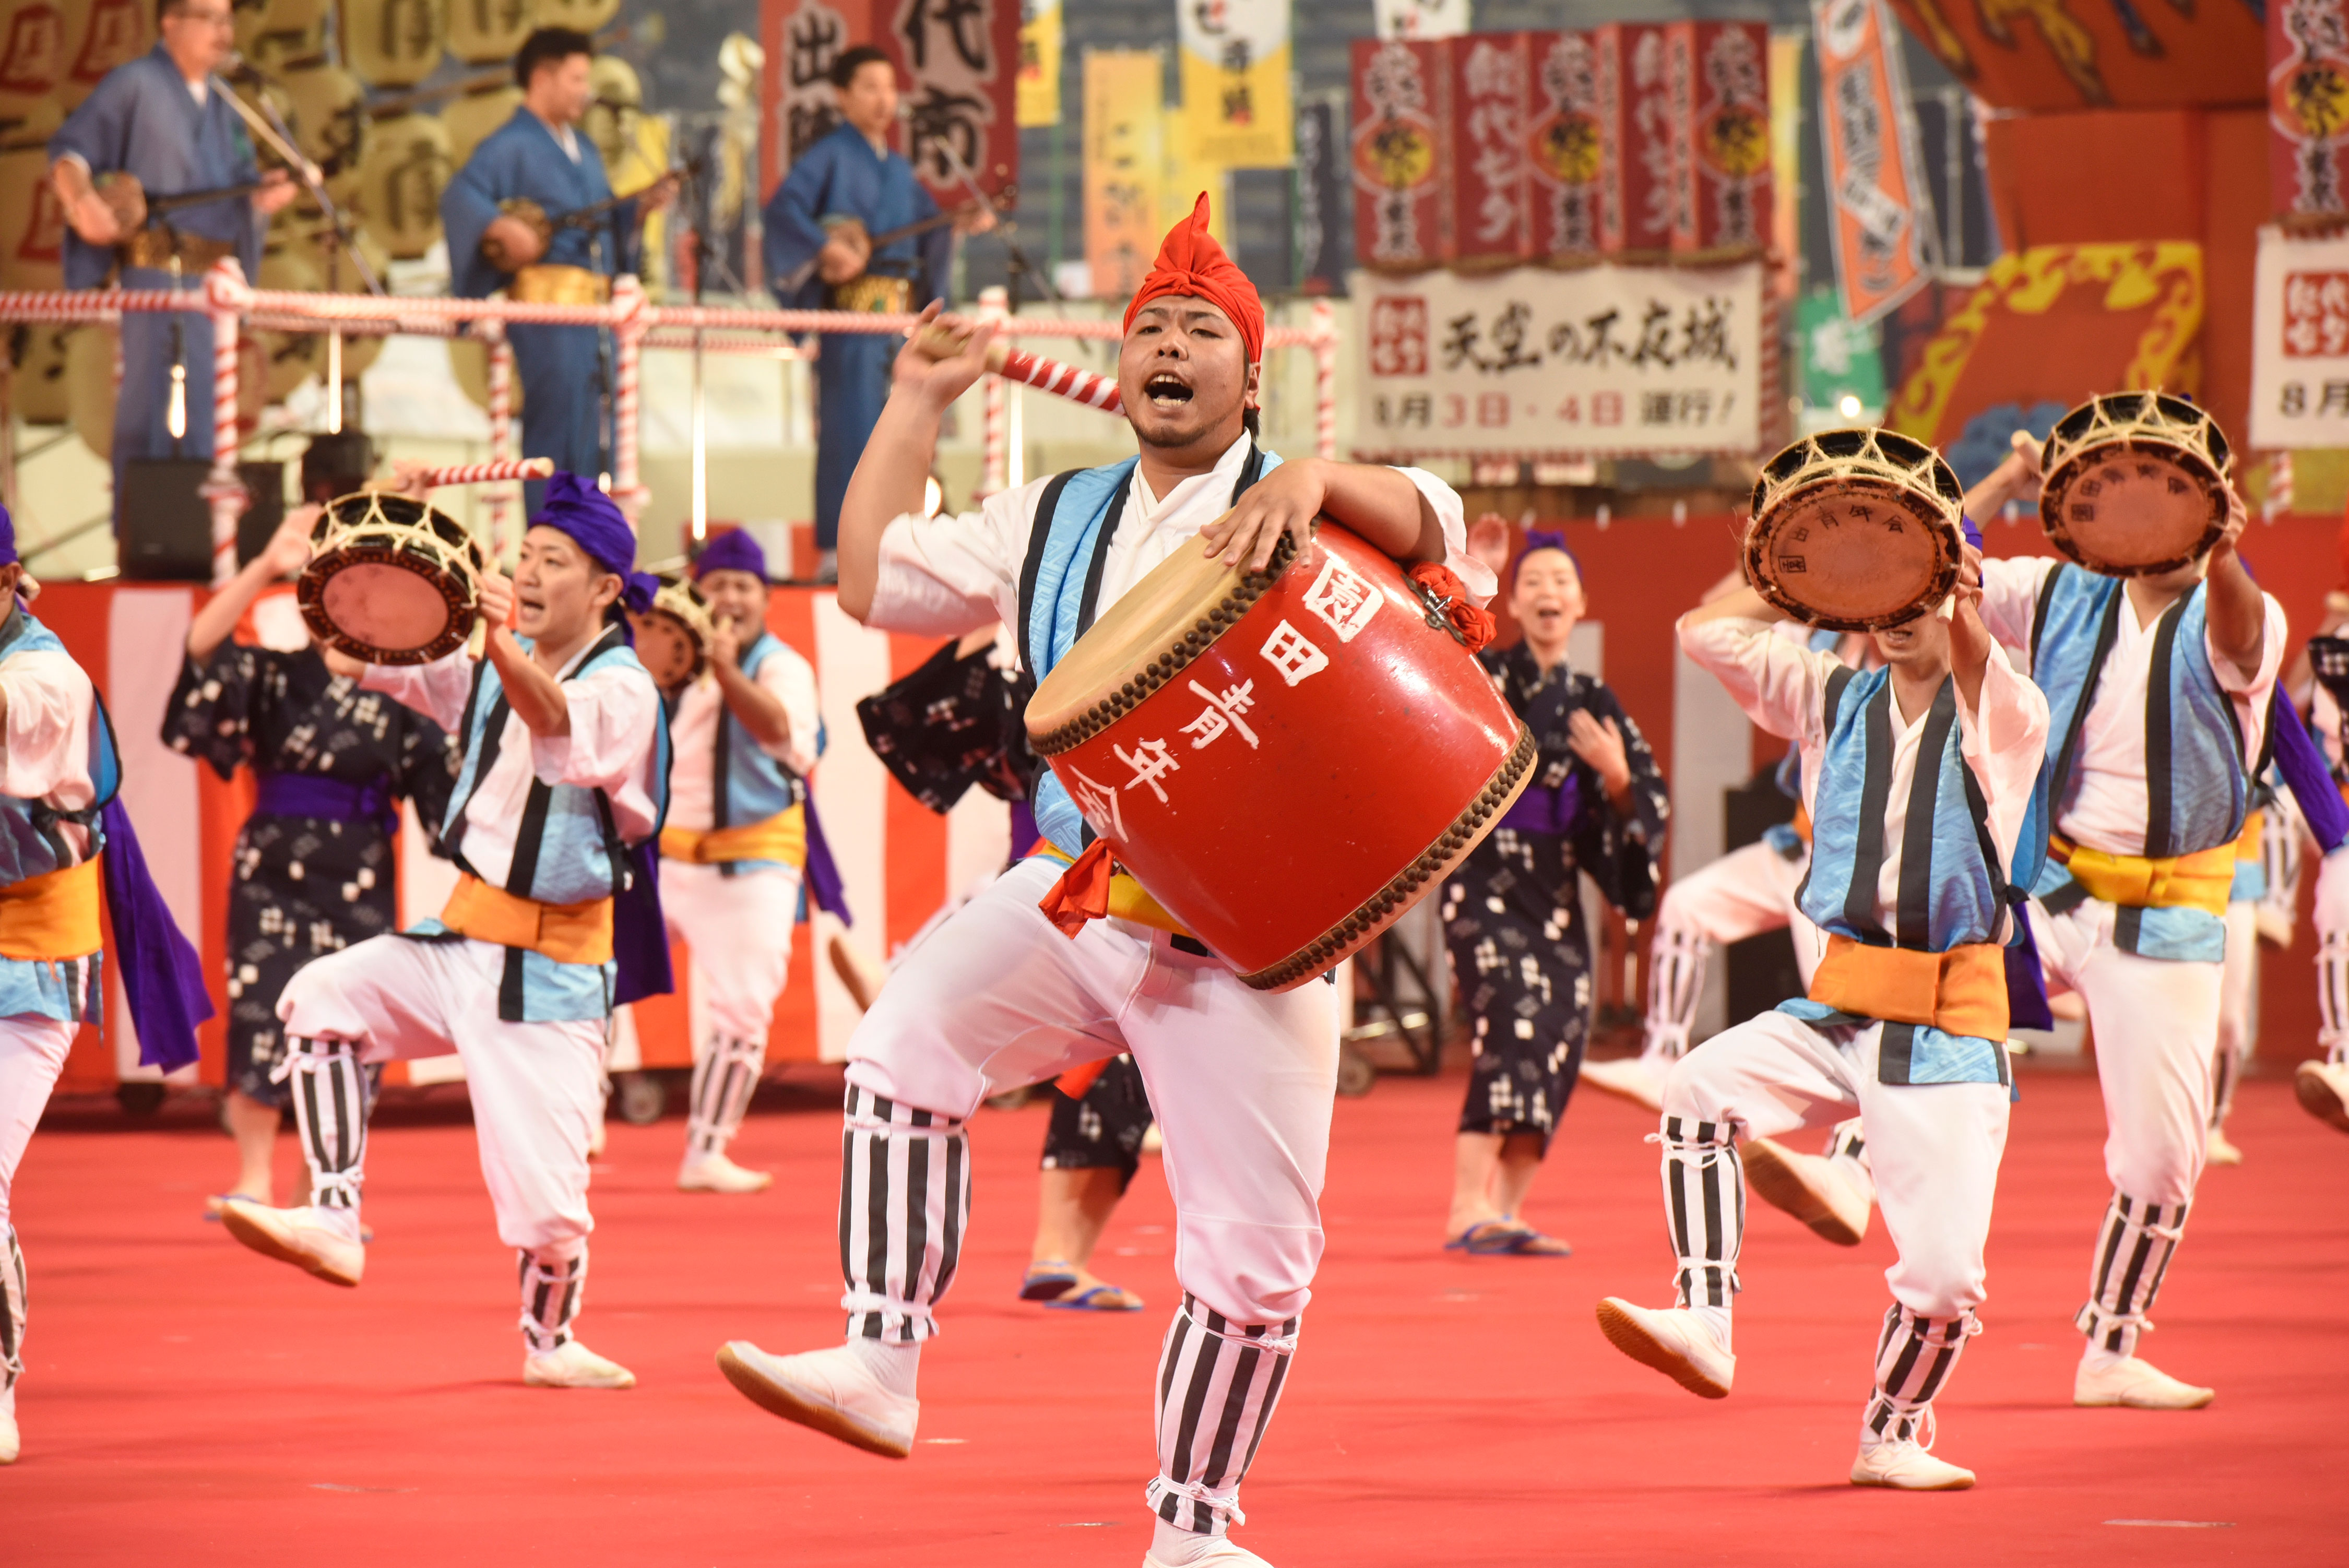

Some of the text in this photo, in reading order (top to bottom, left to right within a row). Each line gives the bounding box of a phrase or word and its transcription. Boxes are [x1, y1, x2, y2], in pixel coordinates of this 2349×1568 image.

[1442, 299, 1737, 373] 天空の不夜城
[1070, 557, 1385, 844] 園田青年会
